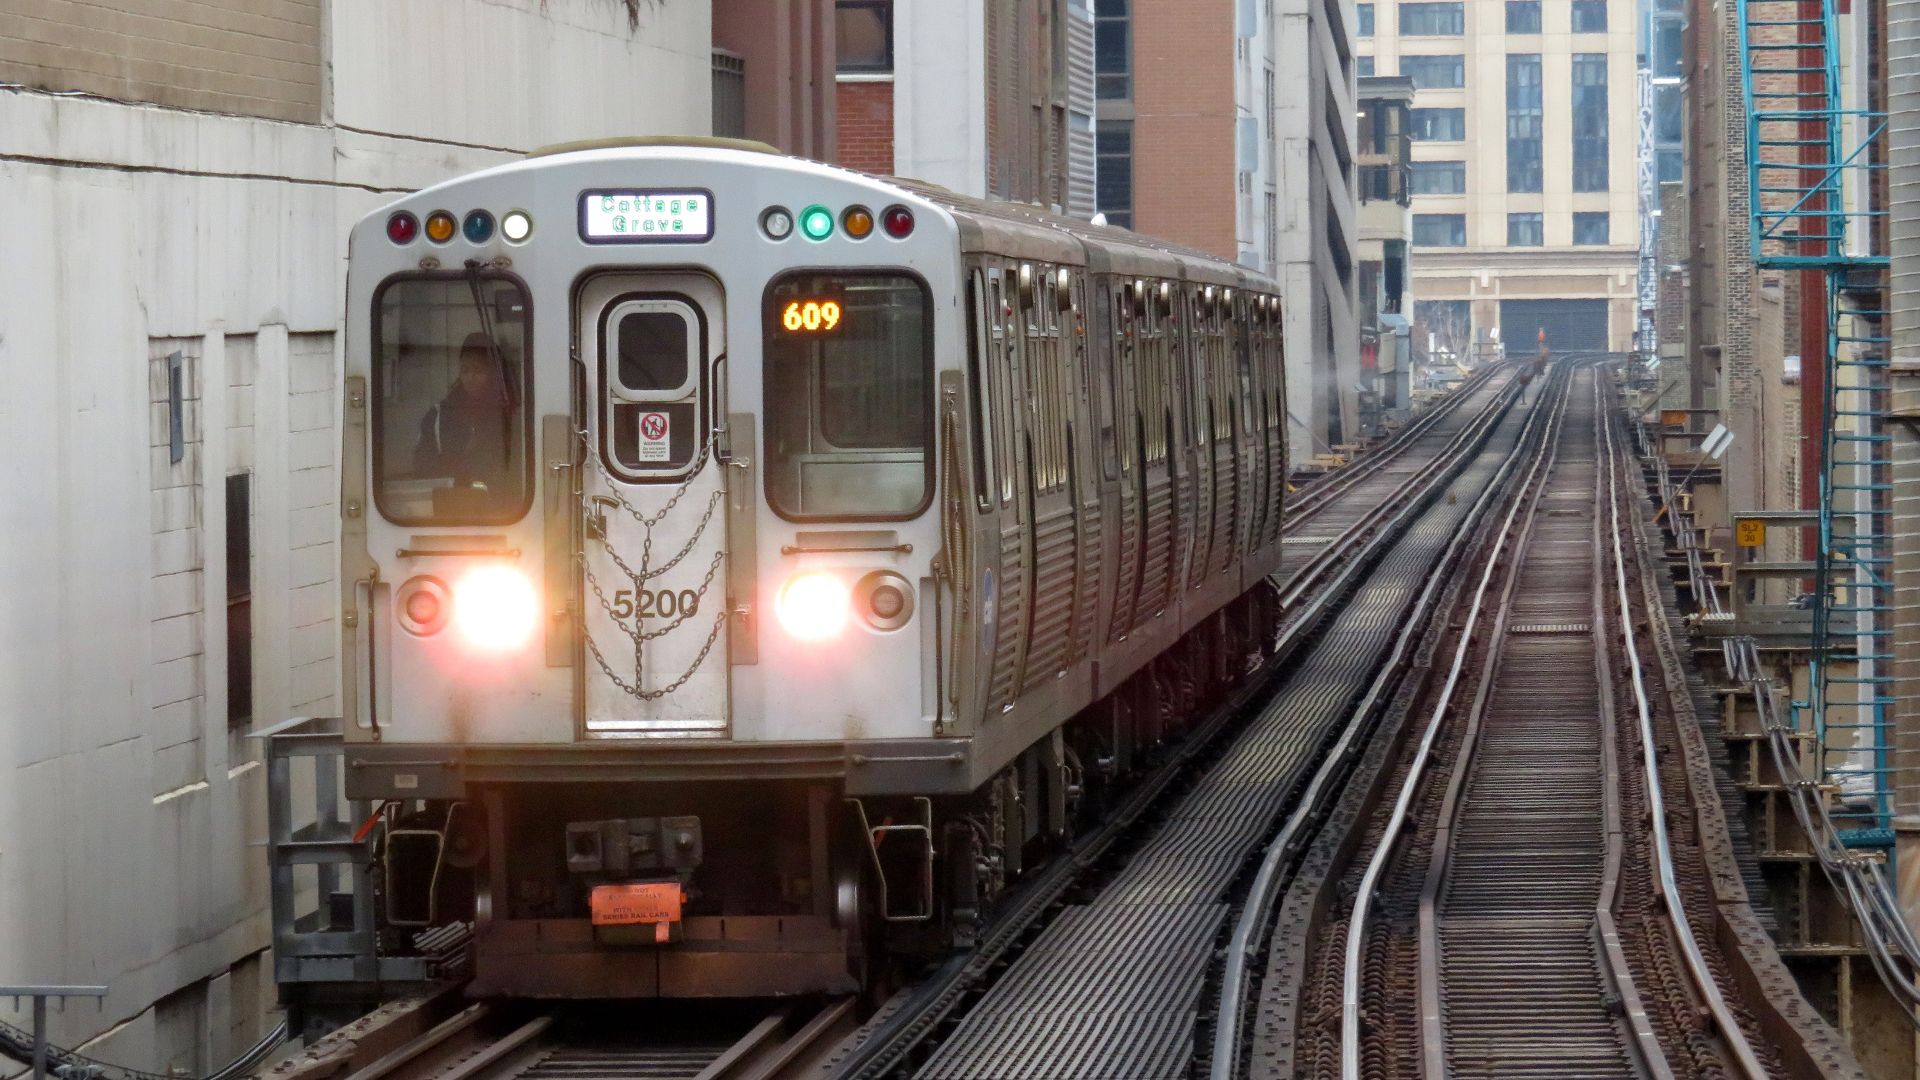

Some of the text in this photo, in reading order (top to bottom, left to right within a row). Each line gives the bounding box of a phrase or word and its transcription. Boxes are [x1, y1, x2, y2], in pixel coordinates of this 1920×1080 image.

[601, 195, 697, 215] Cottage
[612, 215, 683, 232] Grove
[783, 302, 840, 330] 609
[614, 589, 699, 618] 5200
